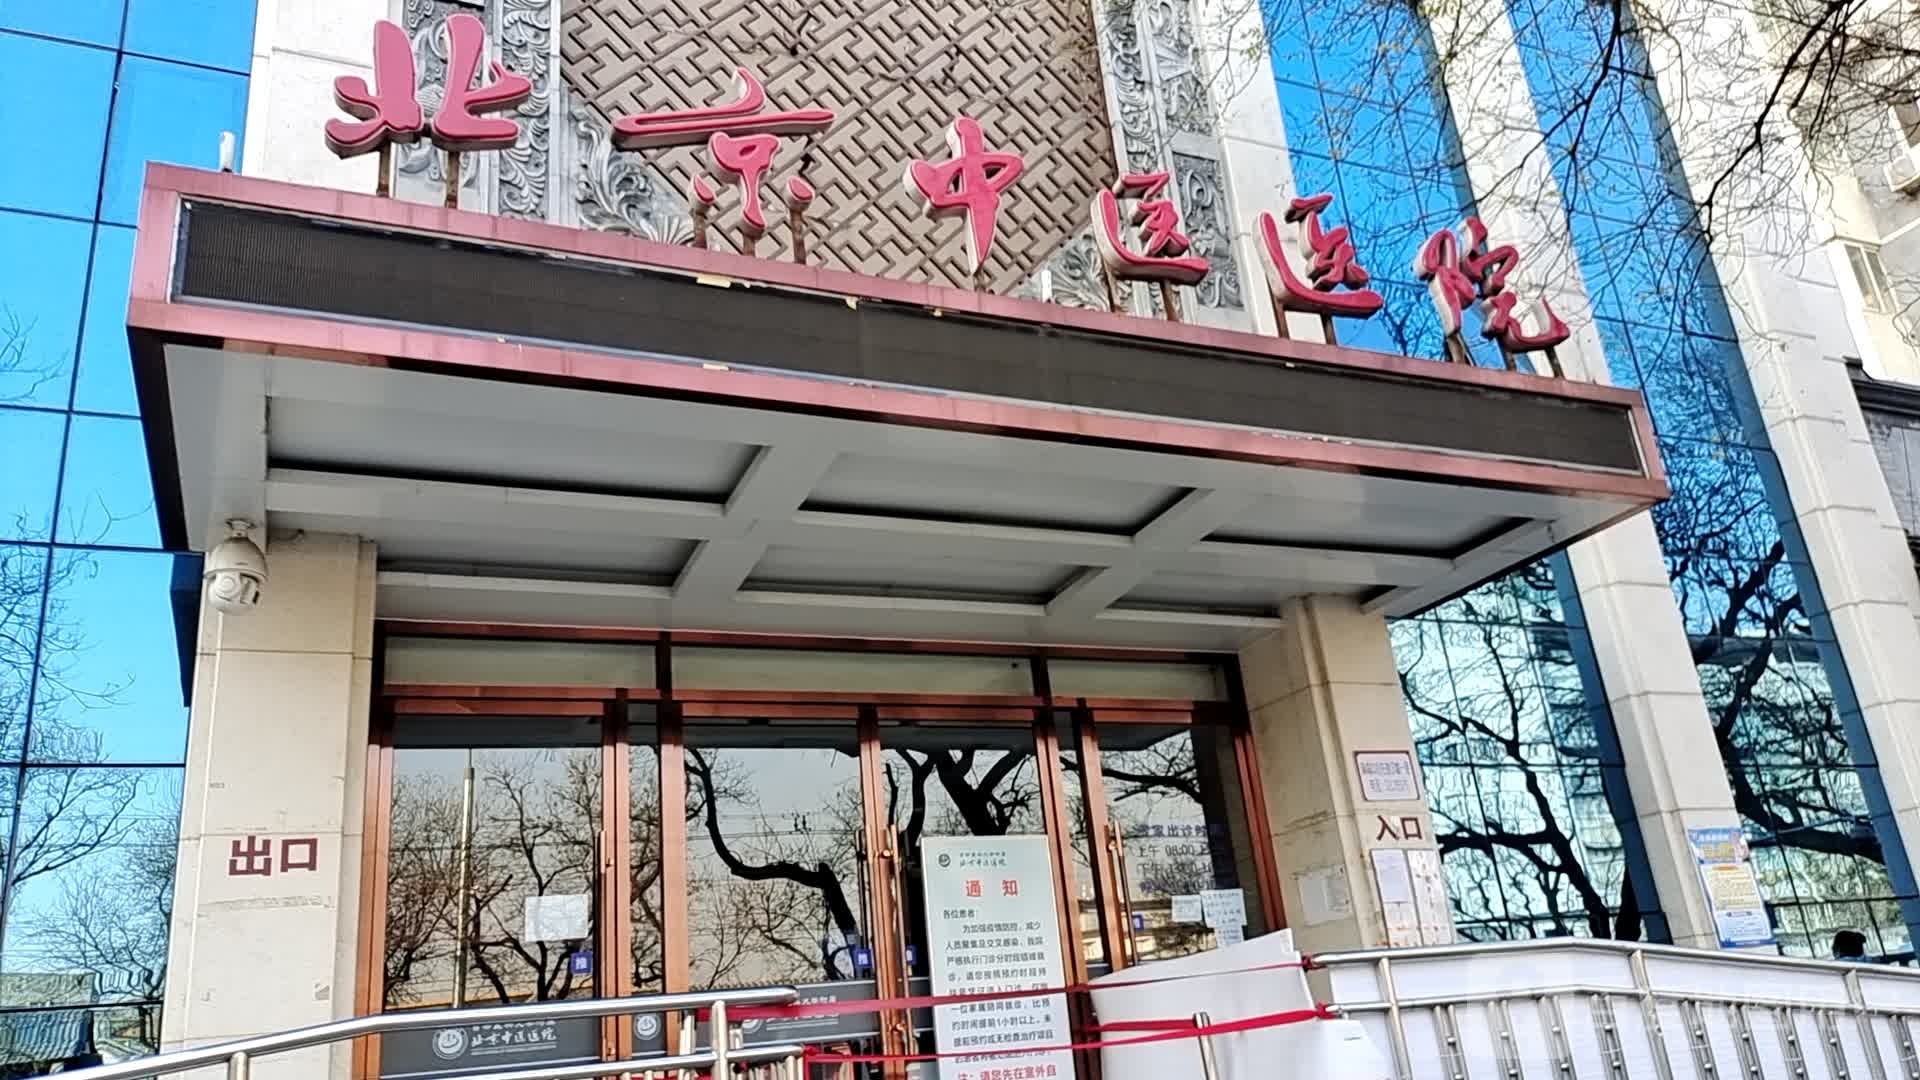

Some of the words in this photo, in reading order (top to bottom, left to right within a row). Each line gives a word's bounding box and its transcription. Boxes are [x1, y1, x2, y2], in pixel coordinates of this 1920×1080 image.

[325, 14, 1570, 353] 北京中医医院
[1376, 815, 1423, 840] 入口
[229, 836, 318, 876] 出口
[965, 880, 1019, 897] 通知
